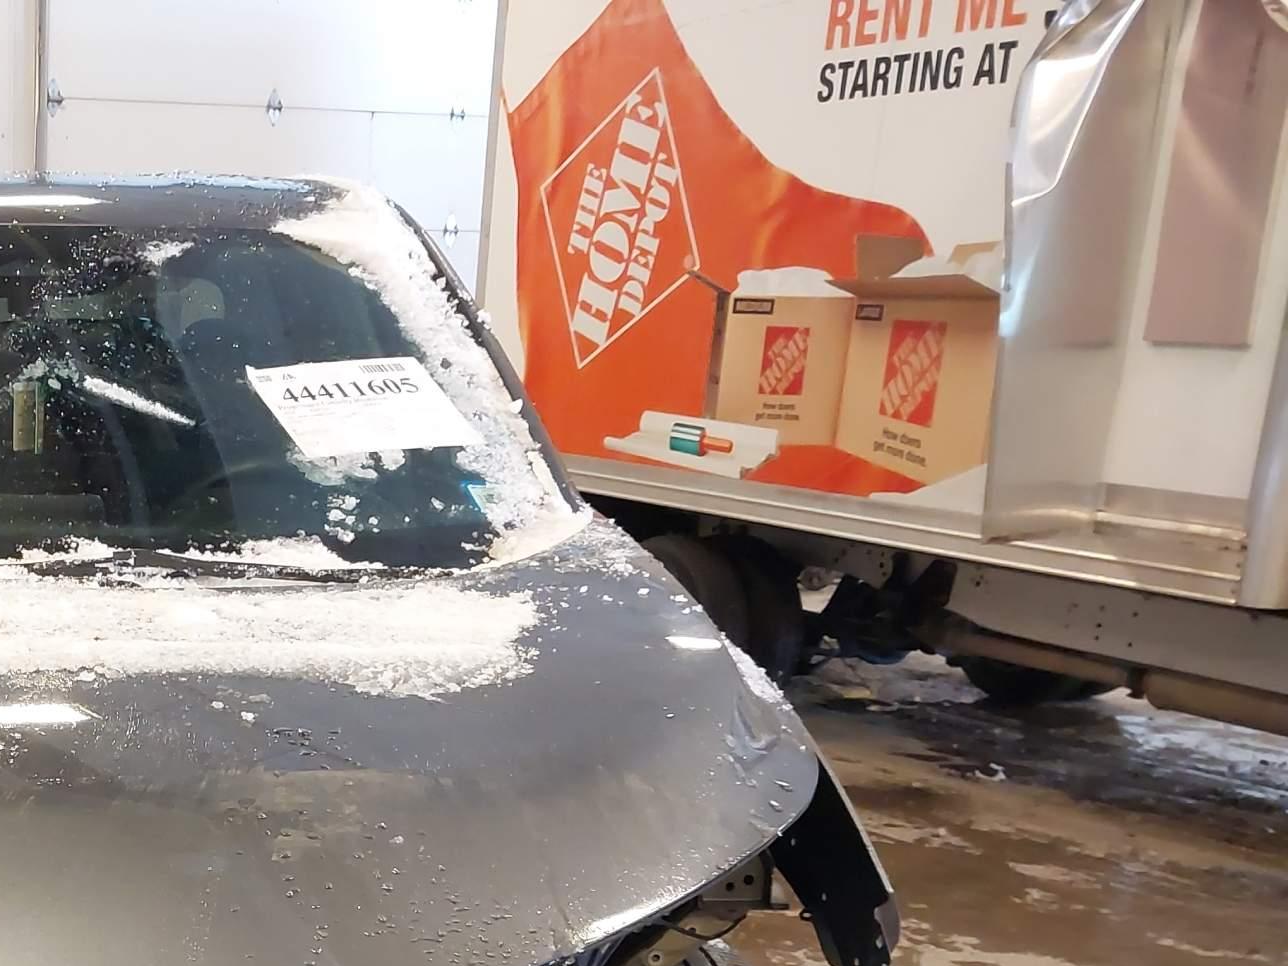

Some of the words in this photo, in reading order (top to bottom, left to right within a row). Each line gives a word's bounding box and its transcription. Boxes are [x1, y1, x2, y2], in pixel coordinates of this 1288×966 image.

[824, 0, 933, 50] RENT
[817, 47, 965, 102] STARTING
[973, 40, 1019, 86] AT
[567, 163, 607, 255] THE
[571, 94, 667, 347] HOME
[619, 153, 680, 316] DEPOT
[282, 377, 420, 403] 44411605
